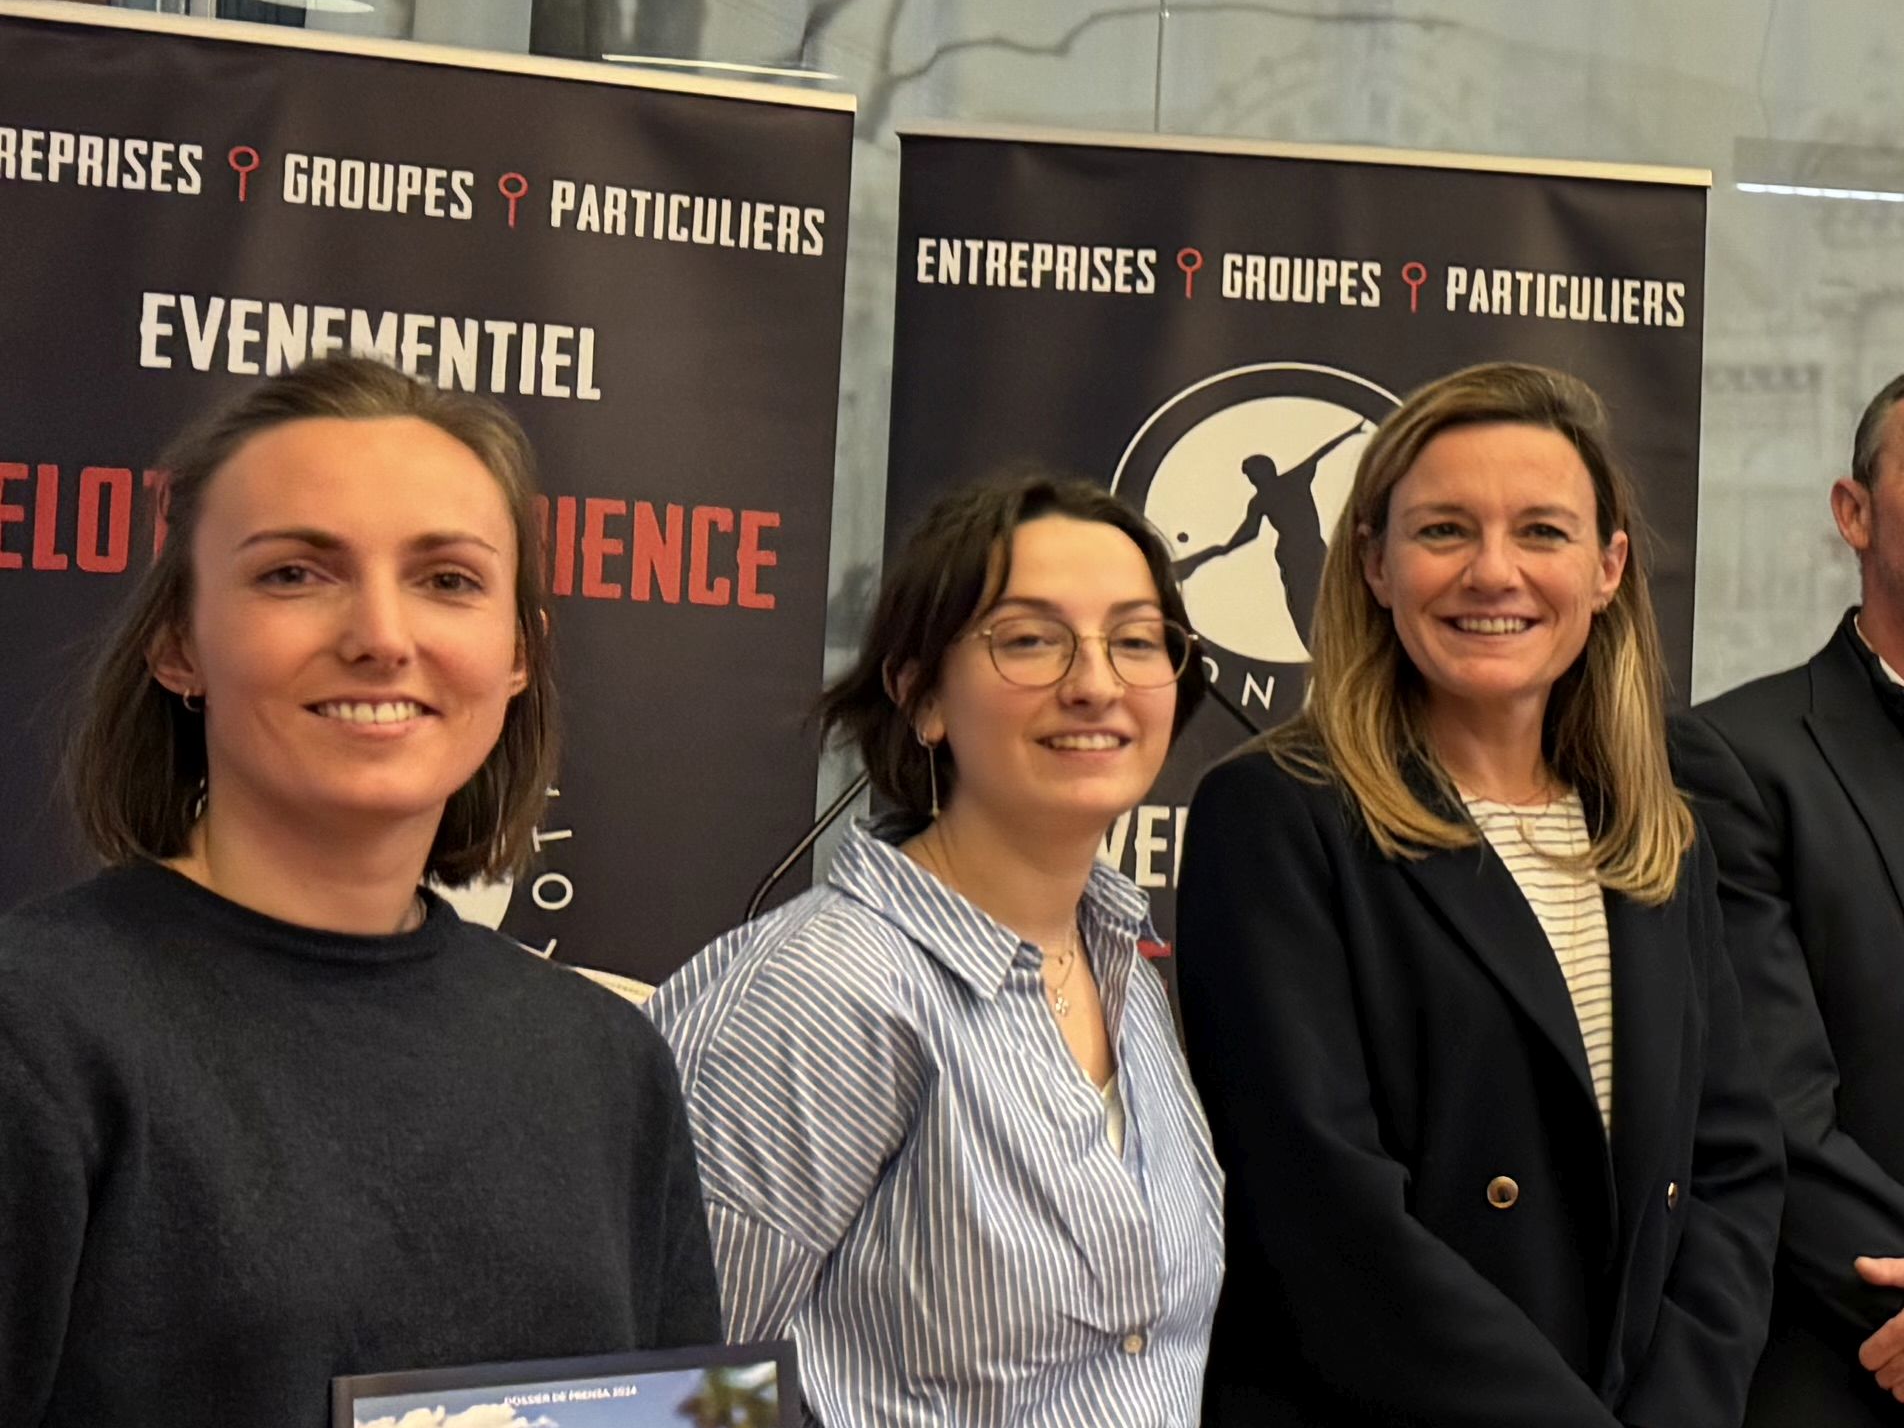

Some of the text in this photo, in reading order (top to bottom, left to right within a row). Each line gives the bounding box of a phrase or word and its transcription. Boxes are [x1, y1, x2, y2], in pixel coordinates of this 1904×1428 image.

[283, 153, 474, 220] GROUPES
[550, 179, 825, 257] PARTICULIERS
[917, 238, 1686, 328] ENTREPRISES GROUPES PARTICULIERS
[139, 291, 601, 401] EVENEMENTIEL
